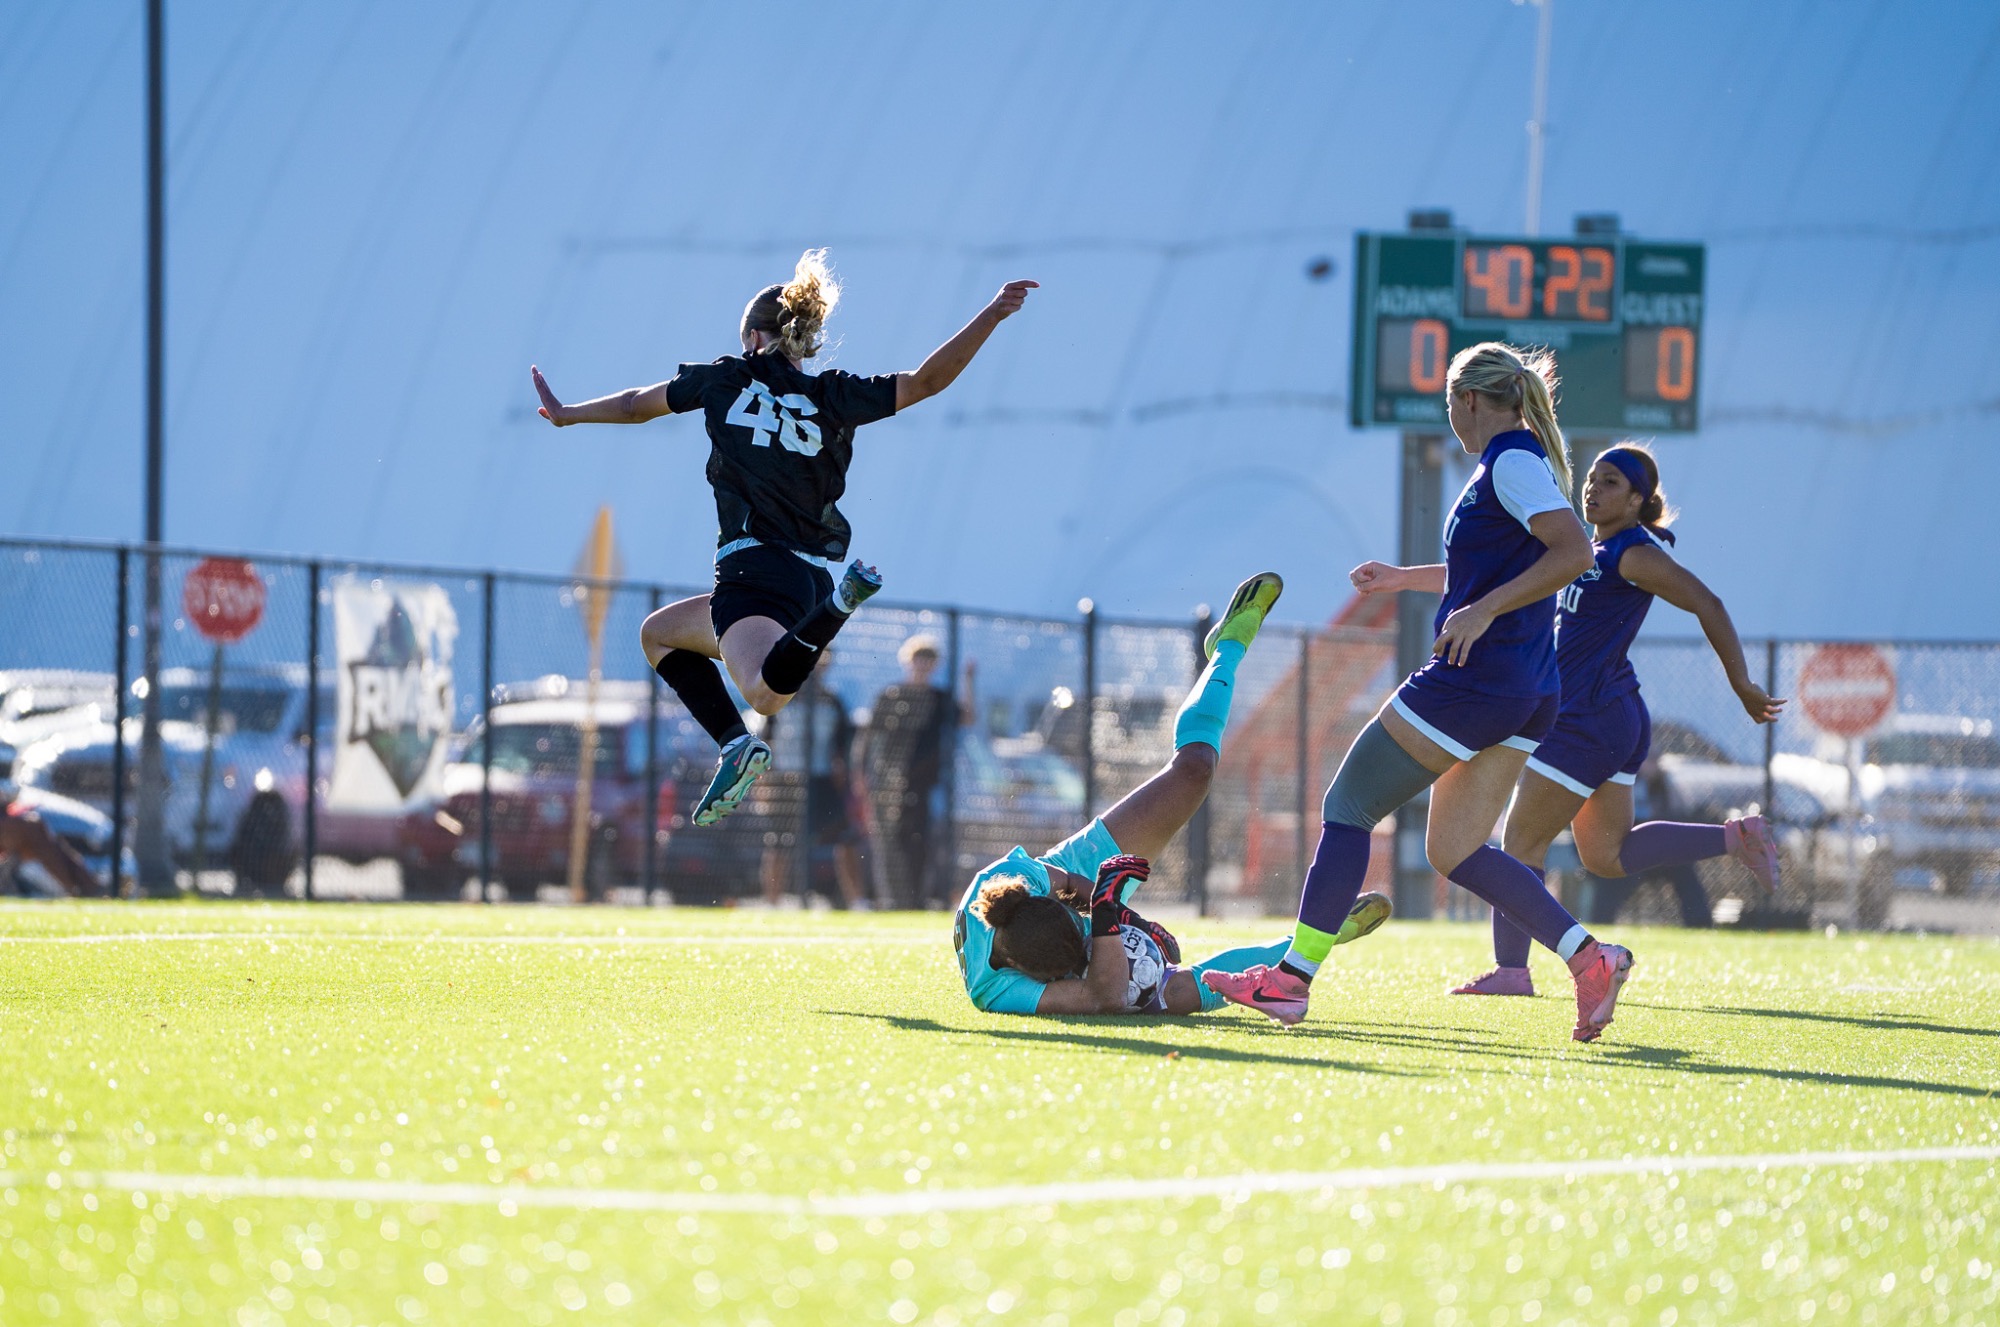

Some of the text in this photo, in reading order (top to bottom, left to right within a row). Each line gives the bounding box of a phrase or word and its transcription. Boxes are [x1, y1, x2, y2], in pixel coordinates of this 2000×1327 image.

[1410, 319, 1448, 393] 0
[1656, 326, 1694, 400] 0
[725, 379, 823, 457] 46
